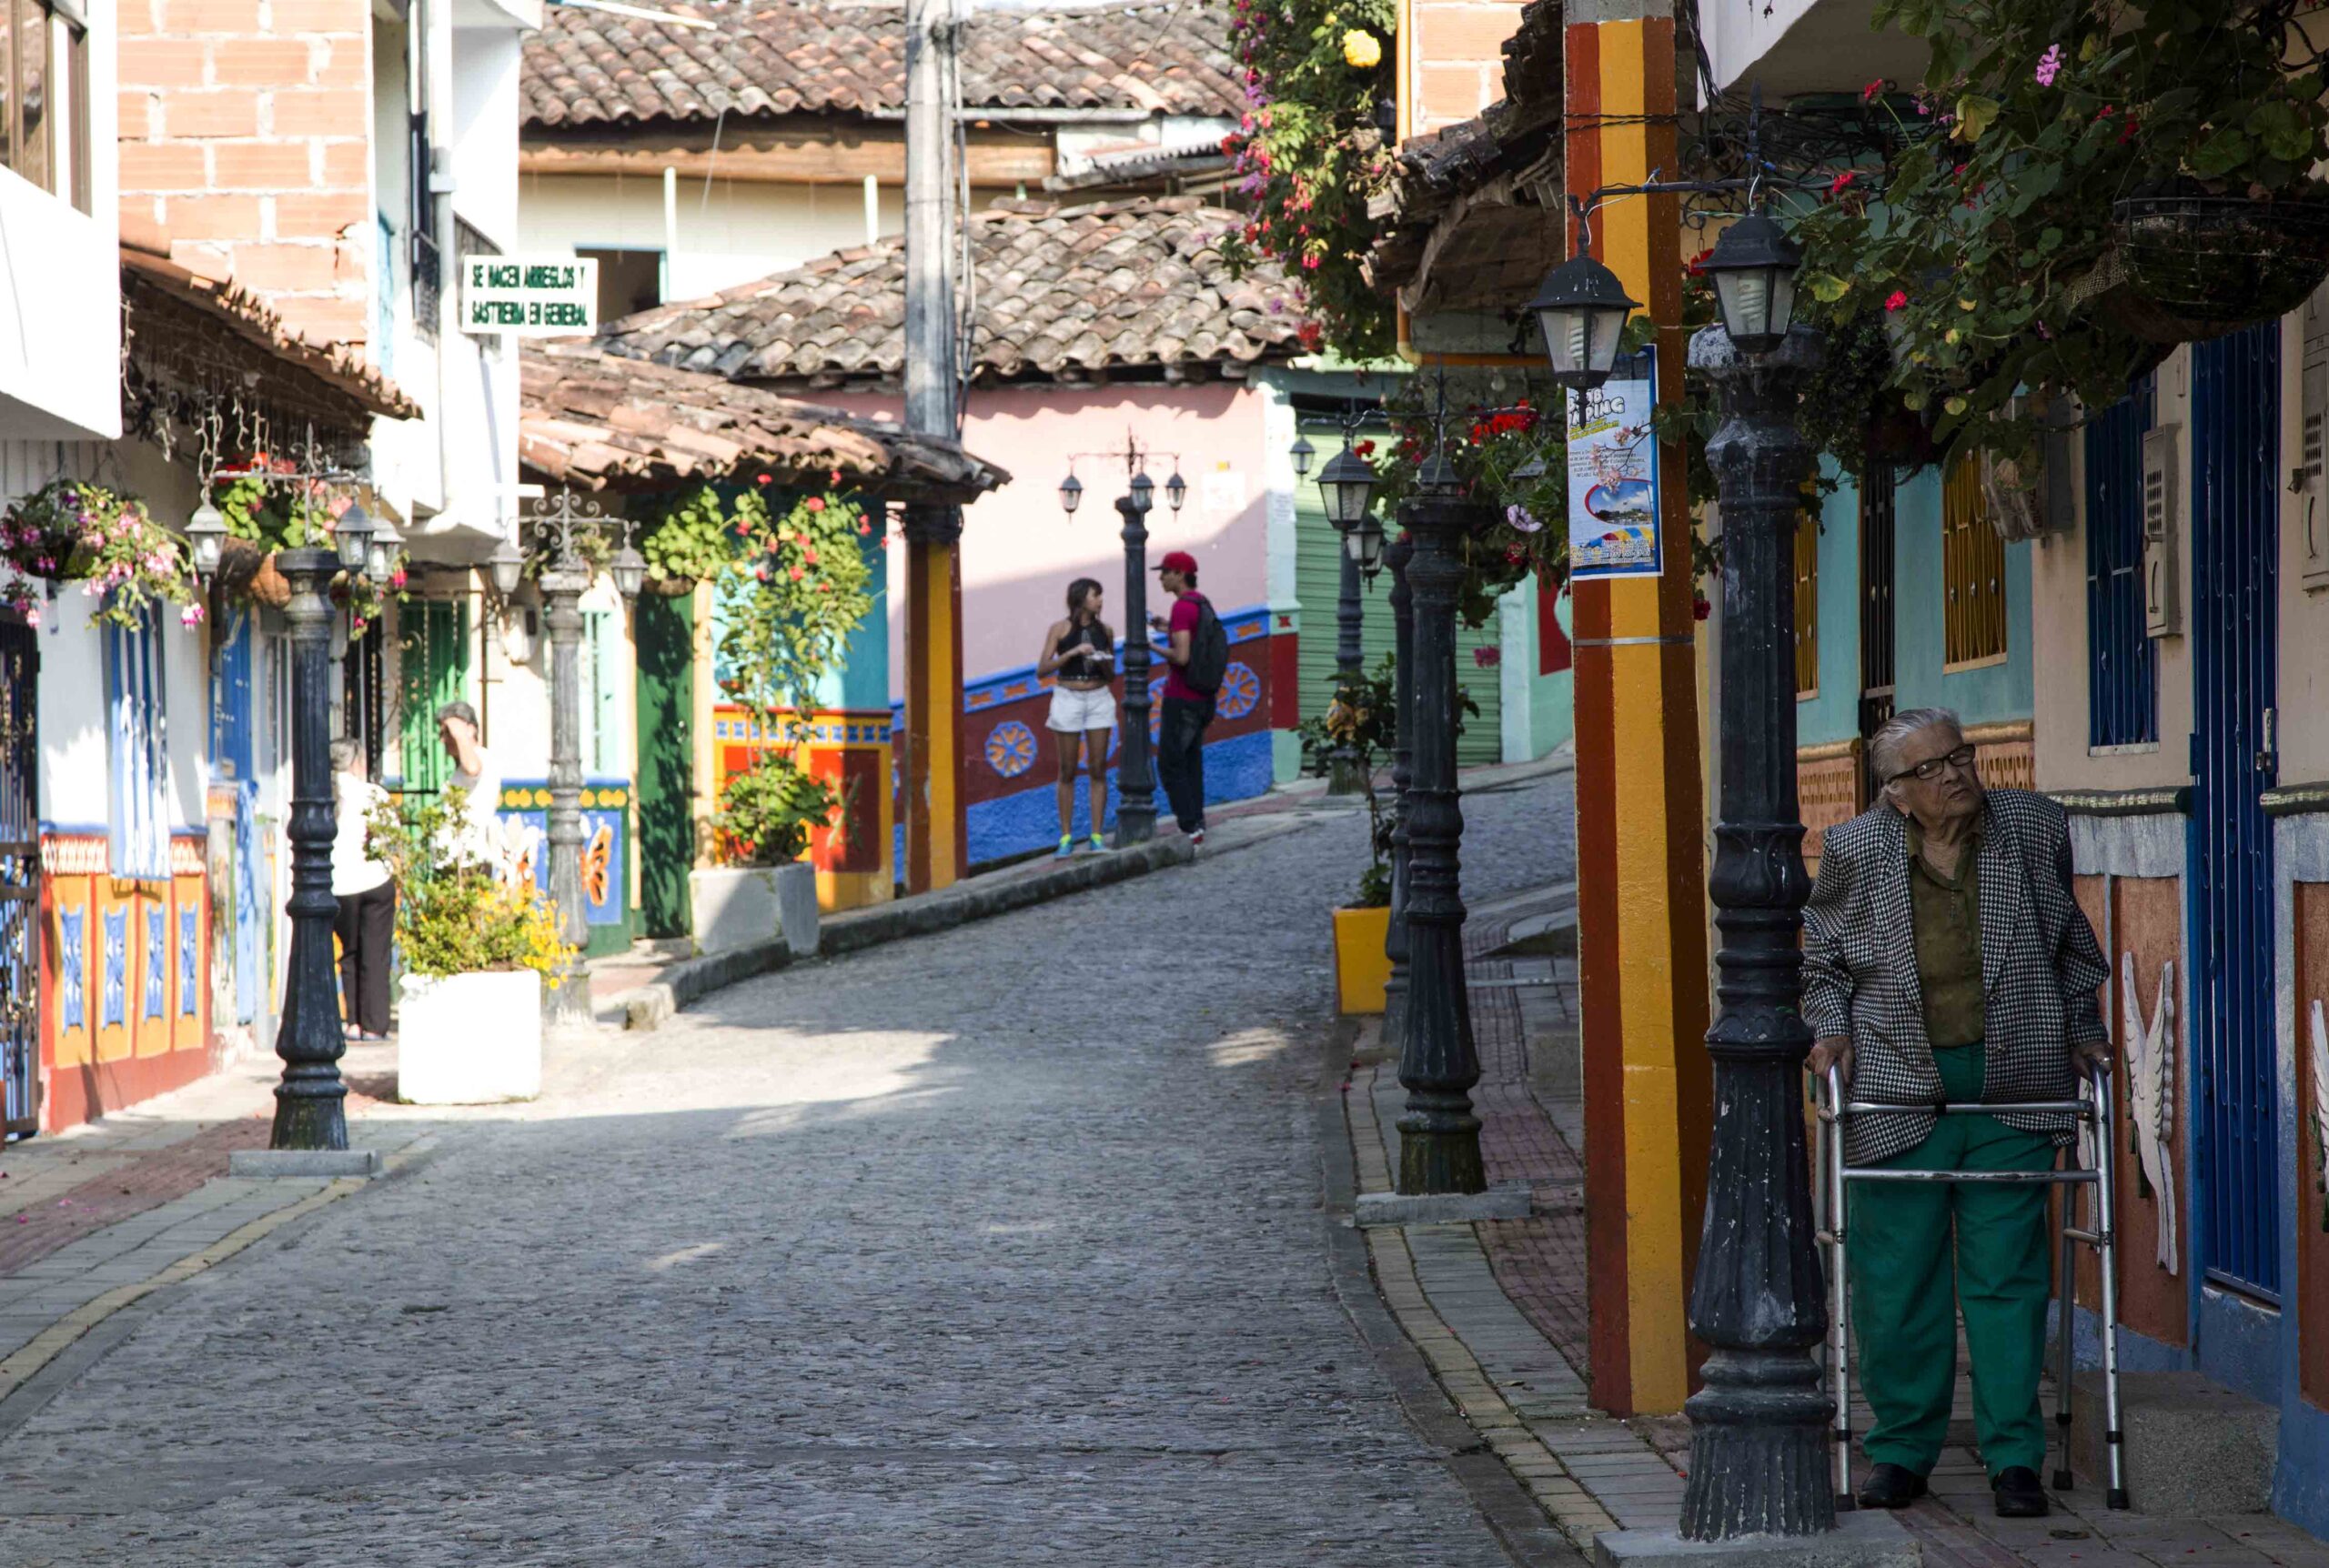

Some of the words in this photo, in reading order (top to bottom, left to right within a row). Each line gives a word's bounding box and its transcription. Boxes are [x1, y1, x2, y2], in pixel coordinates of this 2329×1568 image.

[473, 265, 483, 287] SE
[488, 265, 520, 287] HACEN
[523, 265, 575, 288] ARREGLOS
[580, 266, 585, 288] Y
[472, 301, 526, 325] SASTRERIA
[529, 302, 541, 325] EN
[545, 302, 588, 326] GENERAL
